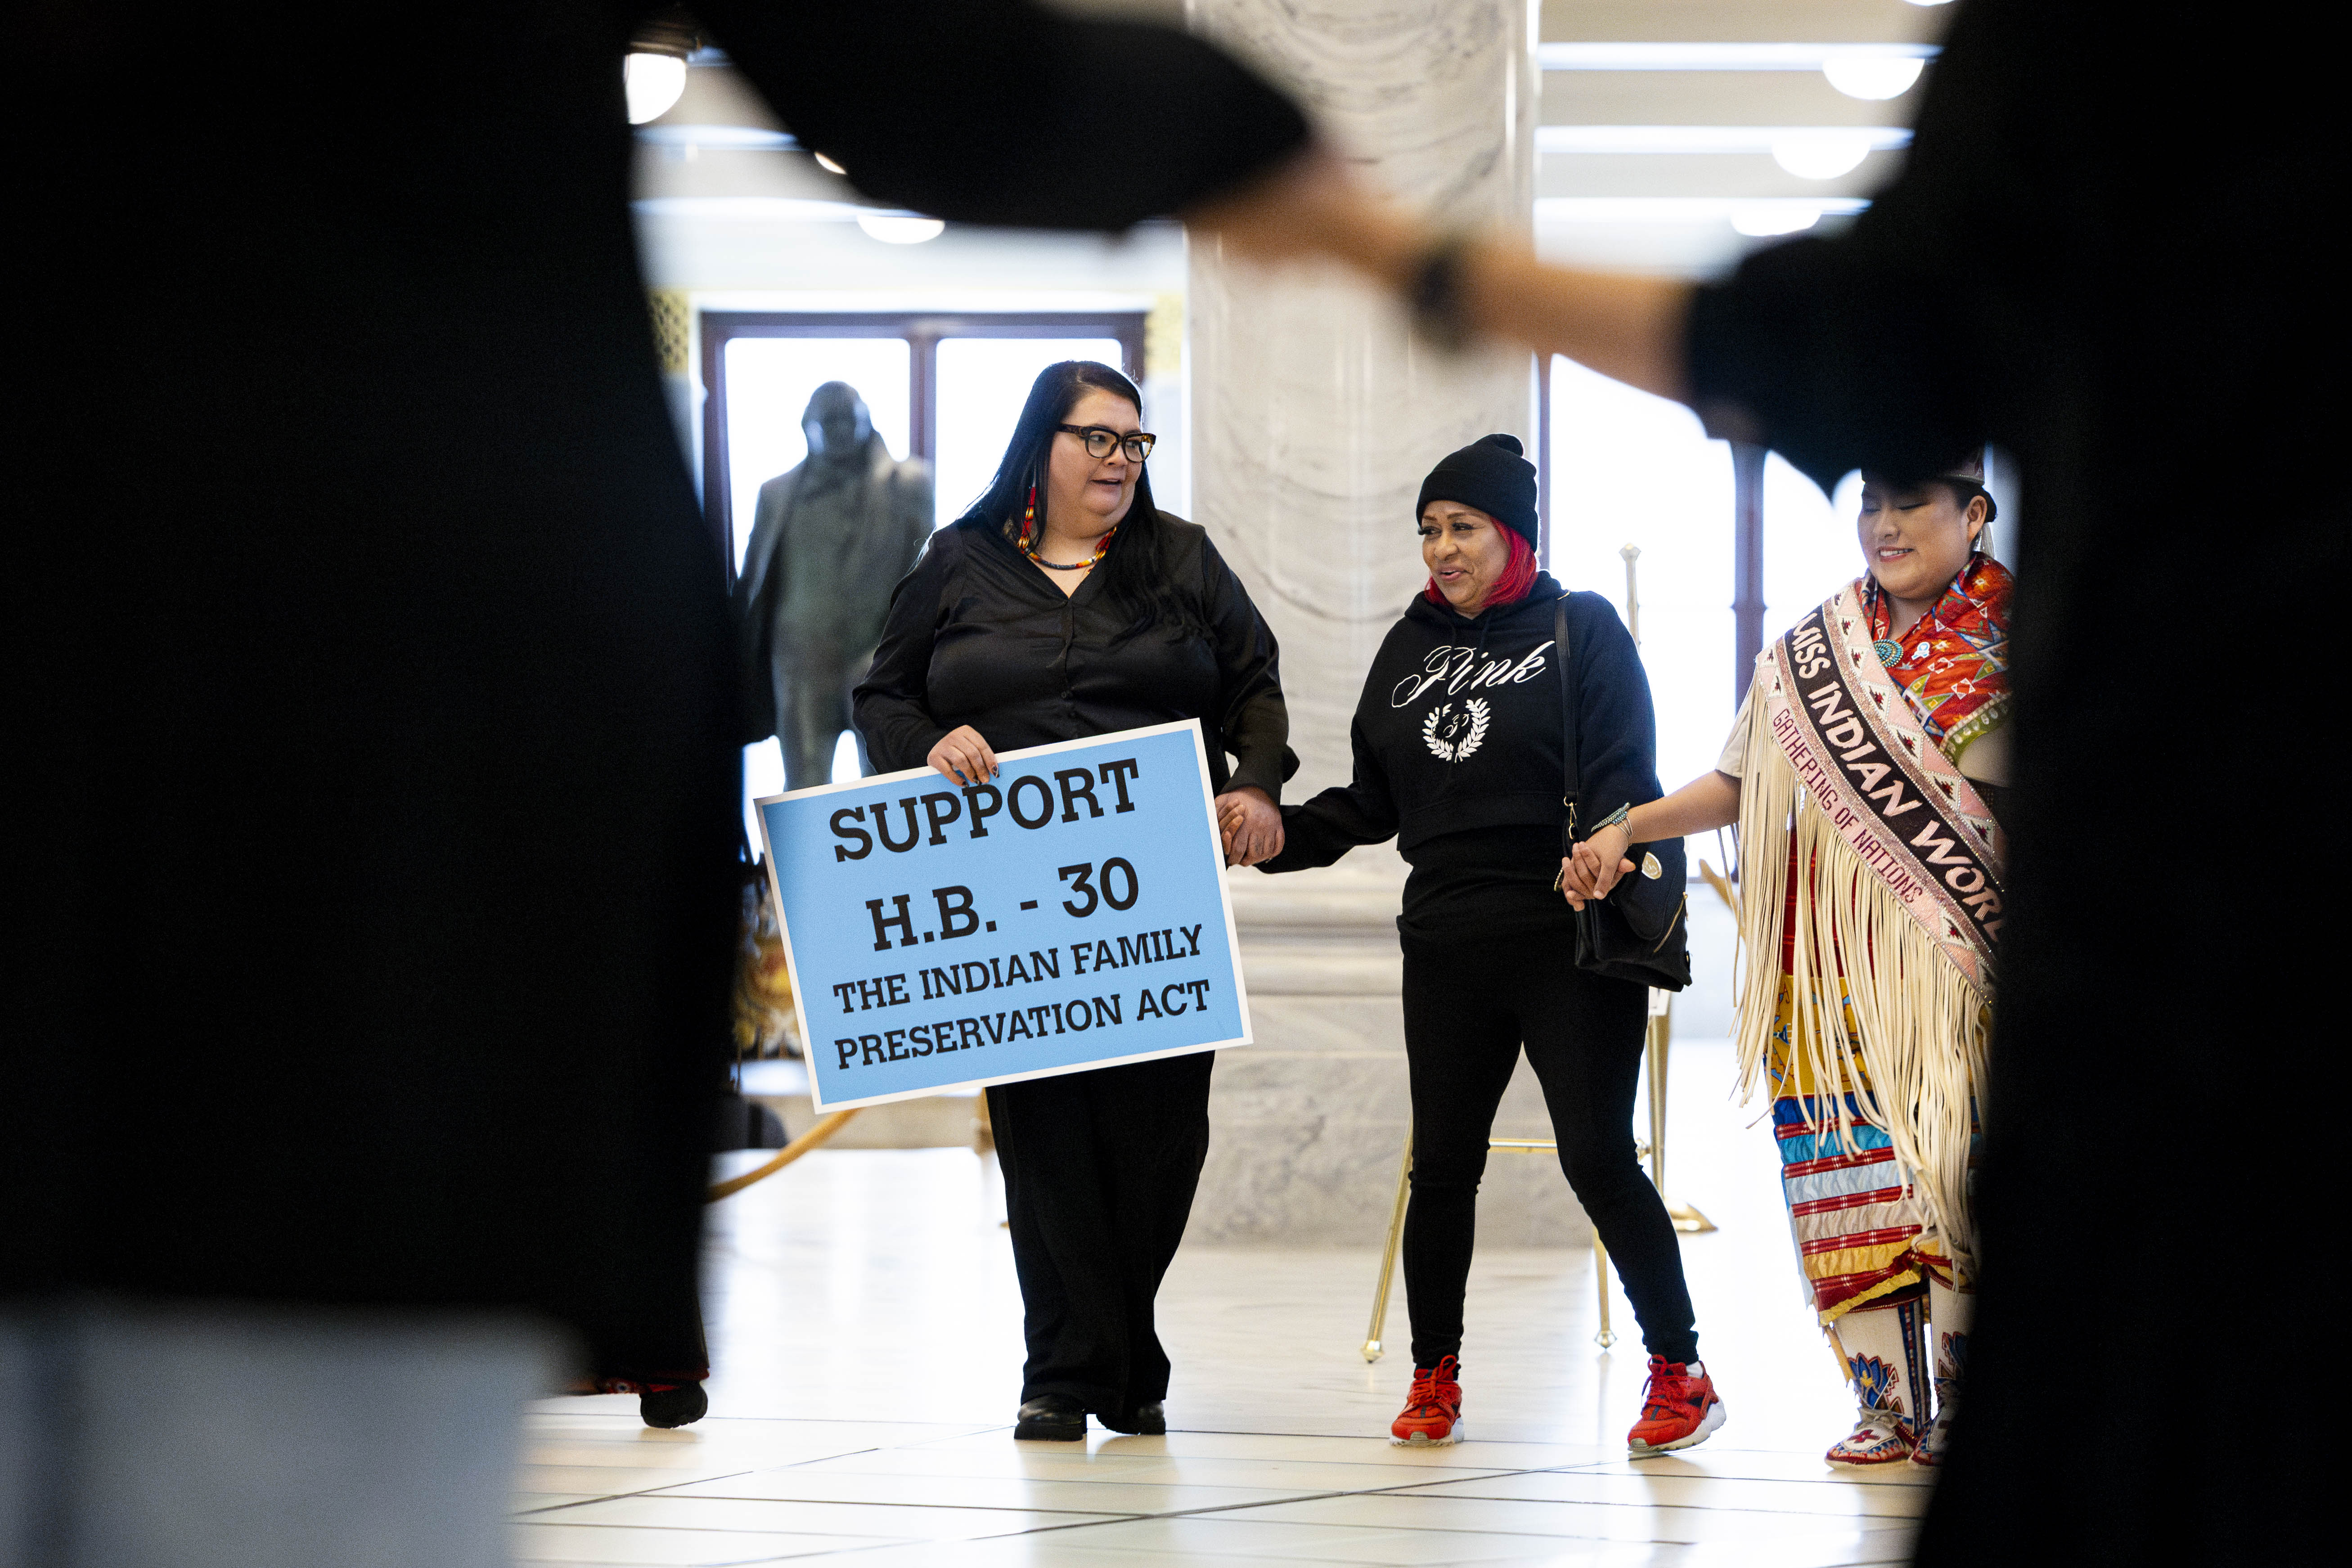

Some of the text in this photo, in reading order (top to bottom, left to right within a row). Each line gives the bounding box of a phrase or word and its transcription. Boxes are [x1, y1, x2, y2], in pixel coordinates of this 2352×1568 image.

[1392, 640, 1555, 708] Pink
[1792, 612, 1831, 679] MISS
[1808, 680, 1923, 817] INDIAN
[829, 758, 1139, 863] SUPPORT
[1773, 709, 1923, 903] GATHERING OF NATIONS
[865, 857, 1139, 952] H.B. - 30
[832, 923, 1202, 1014] THE INDIAN FAMILY
[834, 979, 1210, 1070] PRESERVATION ACT
